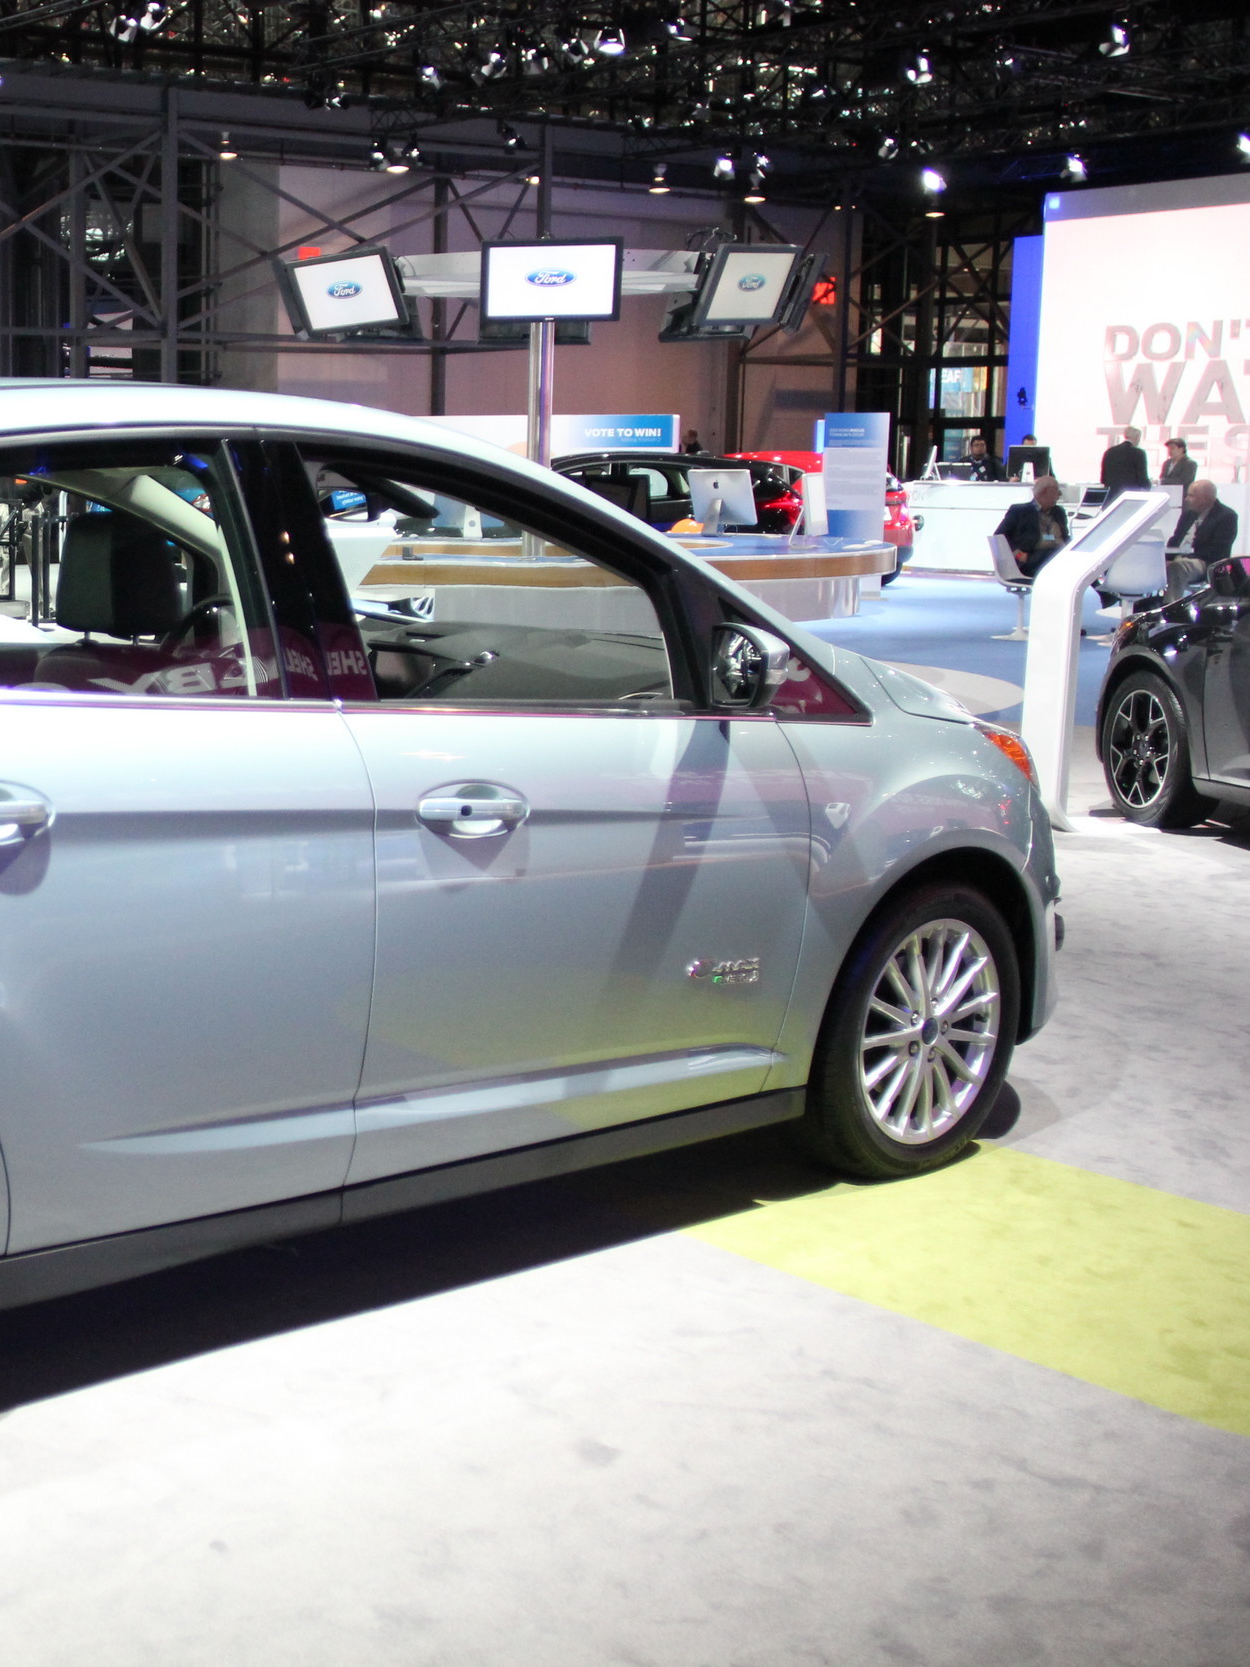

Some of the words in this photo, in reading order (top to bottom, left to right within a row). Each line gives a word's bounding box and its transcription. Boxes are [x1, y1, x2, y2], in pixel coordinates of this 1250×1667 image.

[534, 270, 568, 286] Ford
[332, 282, 357, 298] Ford
[1103, 318, 1250, 362] DON'
[1103, 358, 1250, 426] WA
[585, 428, 615, 437] VOTE
[617, 428, 633, 437] TO
[634, 428, 662, 437] WIN!
